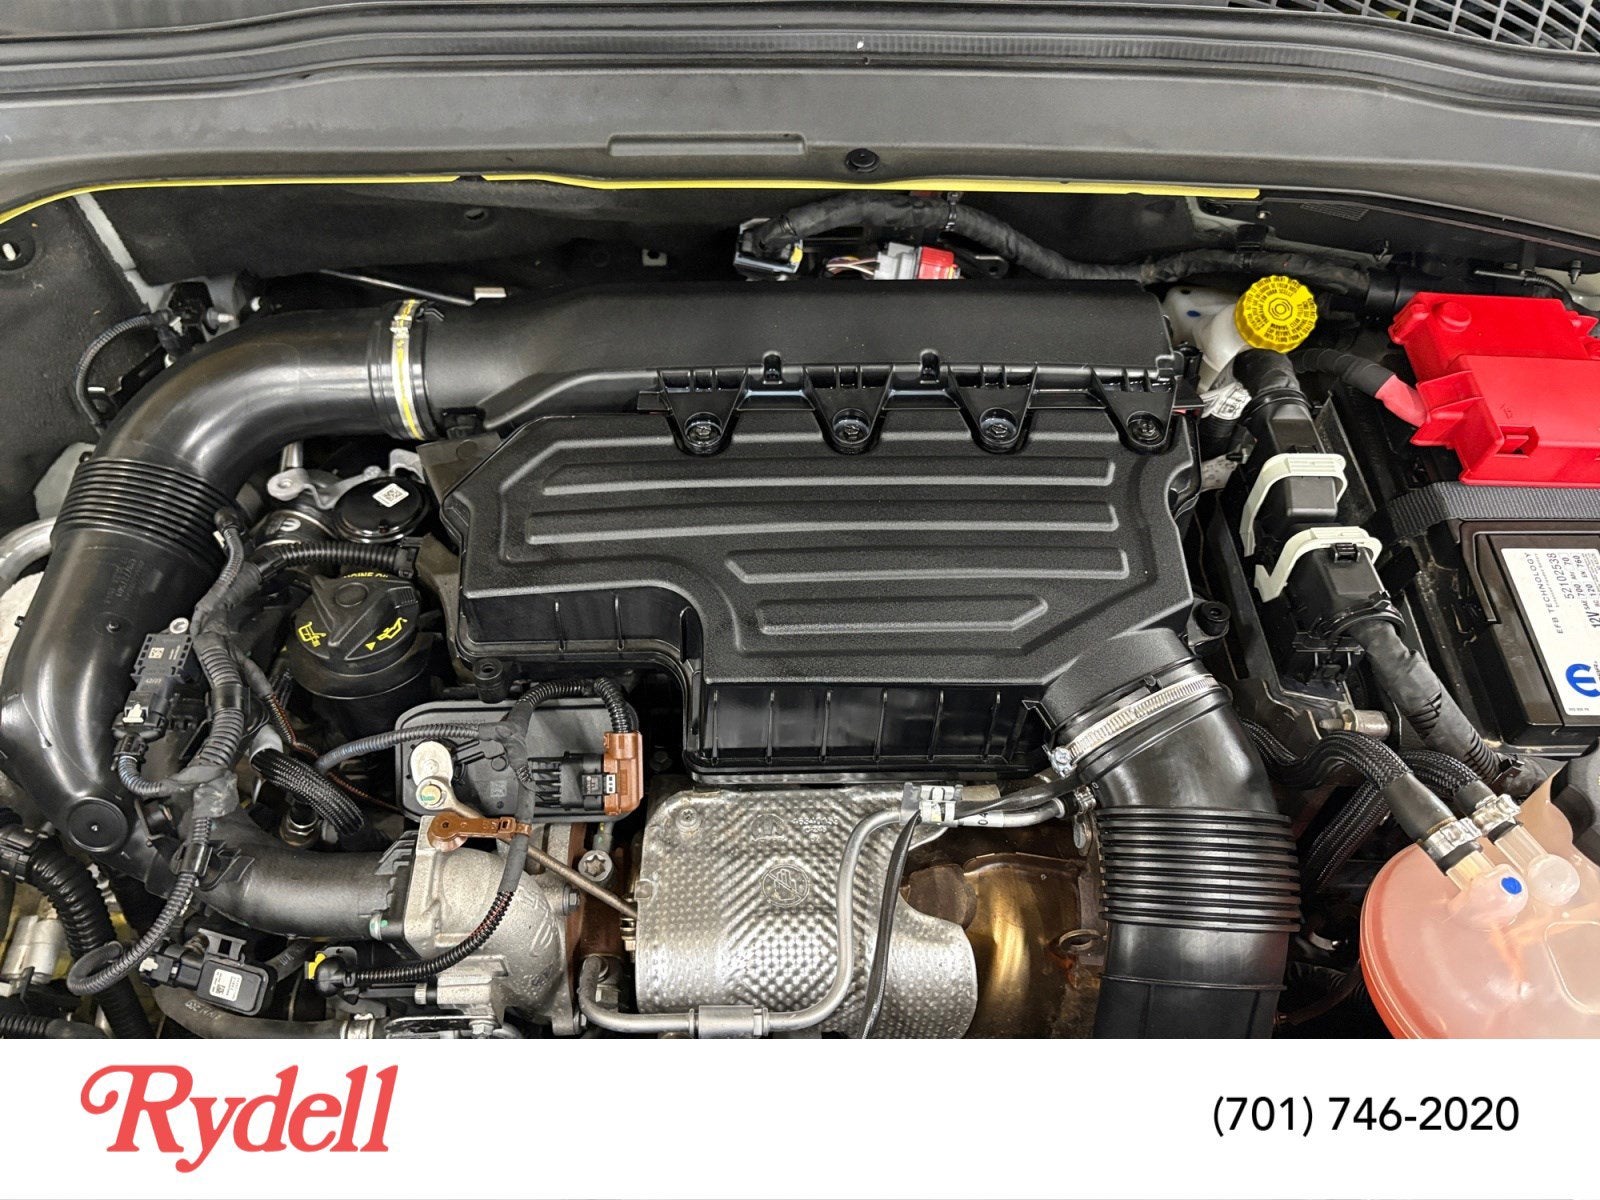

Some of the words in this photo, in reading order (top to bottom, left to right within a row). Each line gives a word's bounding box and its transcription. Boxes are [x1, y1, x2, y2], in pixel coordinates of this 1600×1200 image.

[1546, 552, 1575, 600] 52102538
[1572, 555, 1584, 568] 760
[1524, 552, 1555, 614] TECHNOLOGY
[1573, 583, 1586, 597] 700
